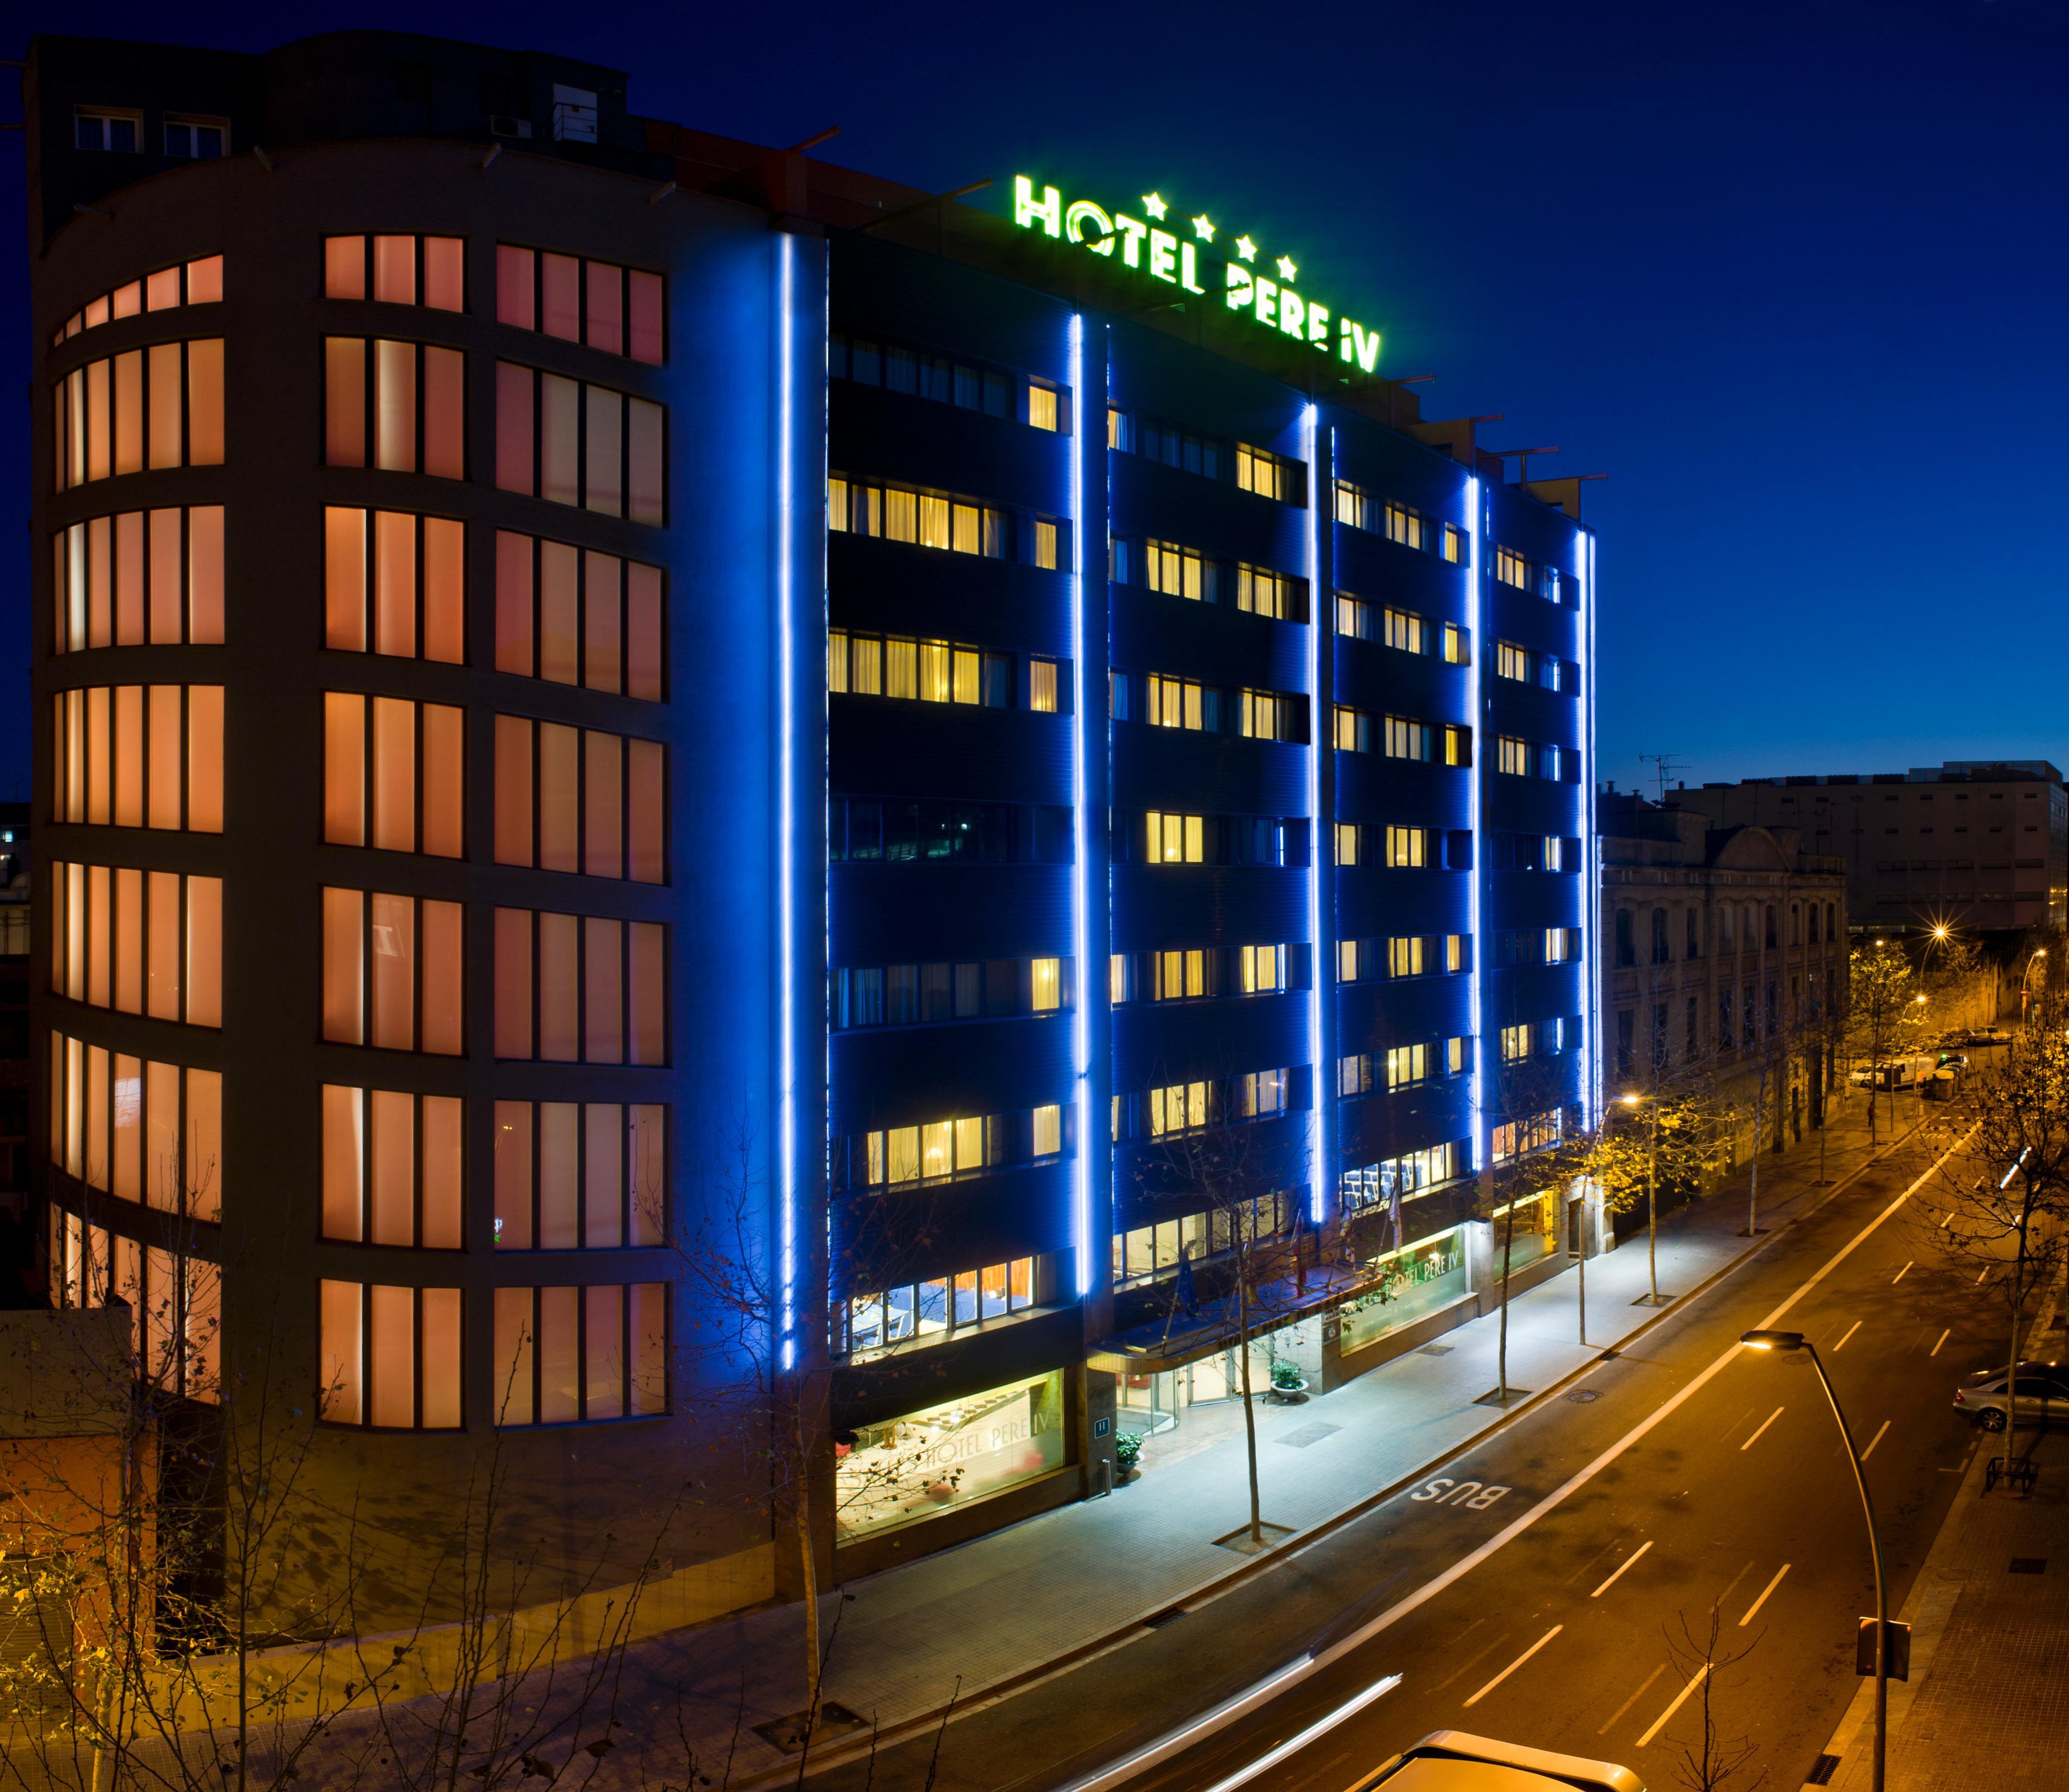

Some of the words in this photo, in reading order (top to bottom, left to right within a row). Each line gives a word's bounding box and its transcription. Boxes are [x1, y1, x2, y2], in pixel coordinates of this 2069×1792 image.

[1015, 175, 1206, 295] HOTEL
[1227, 262, 1329, 351] PERE
[1340, 318, 1380, 373] IV
[1424, 1255, 1446, 1282] PERE
[1449, 1249, 1459, 1271] IV
[926, 1433, 982, 1469] HOTEL
[992, 1418, 1027, 1447] PERE
[1034, 1411, 1050, 1434] IV
[1410, 1478, 1512, 1510] BUS
